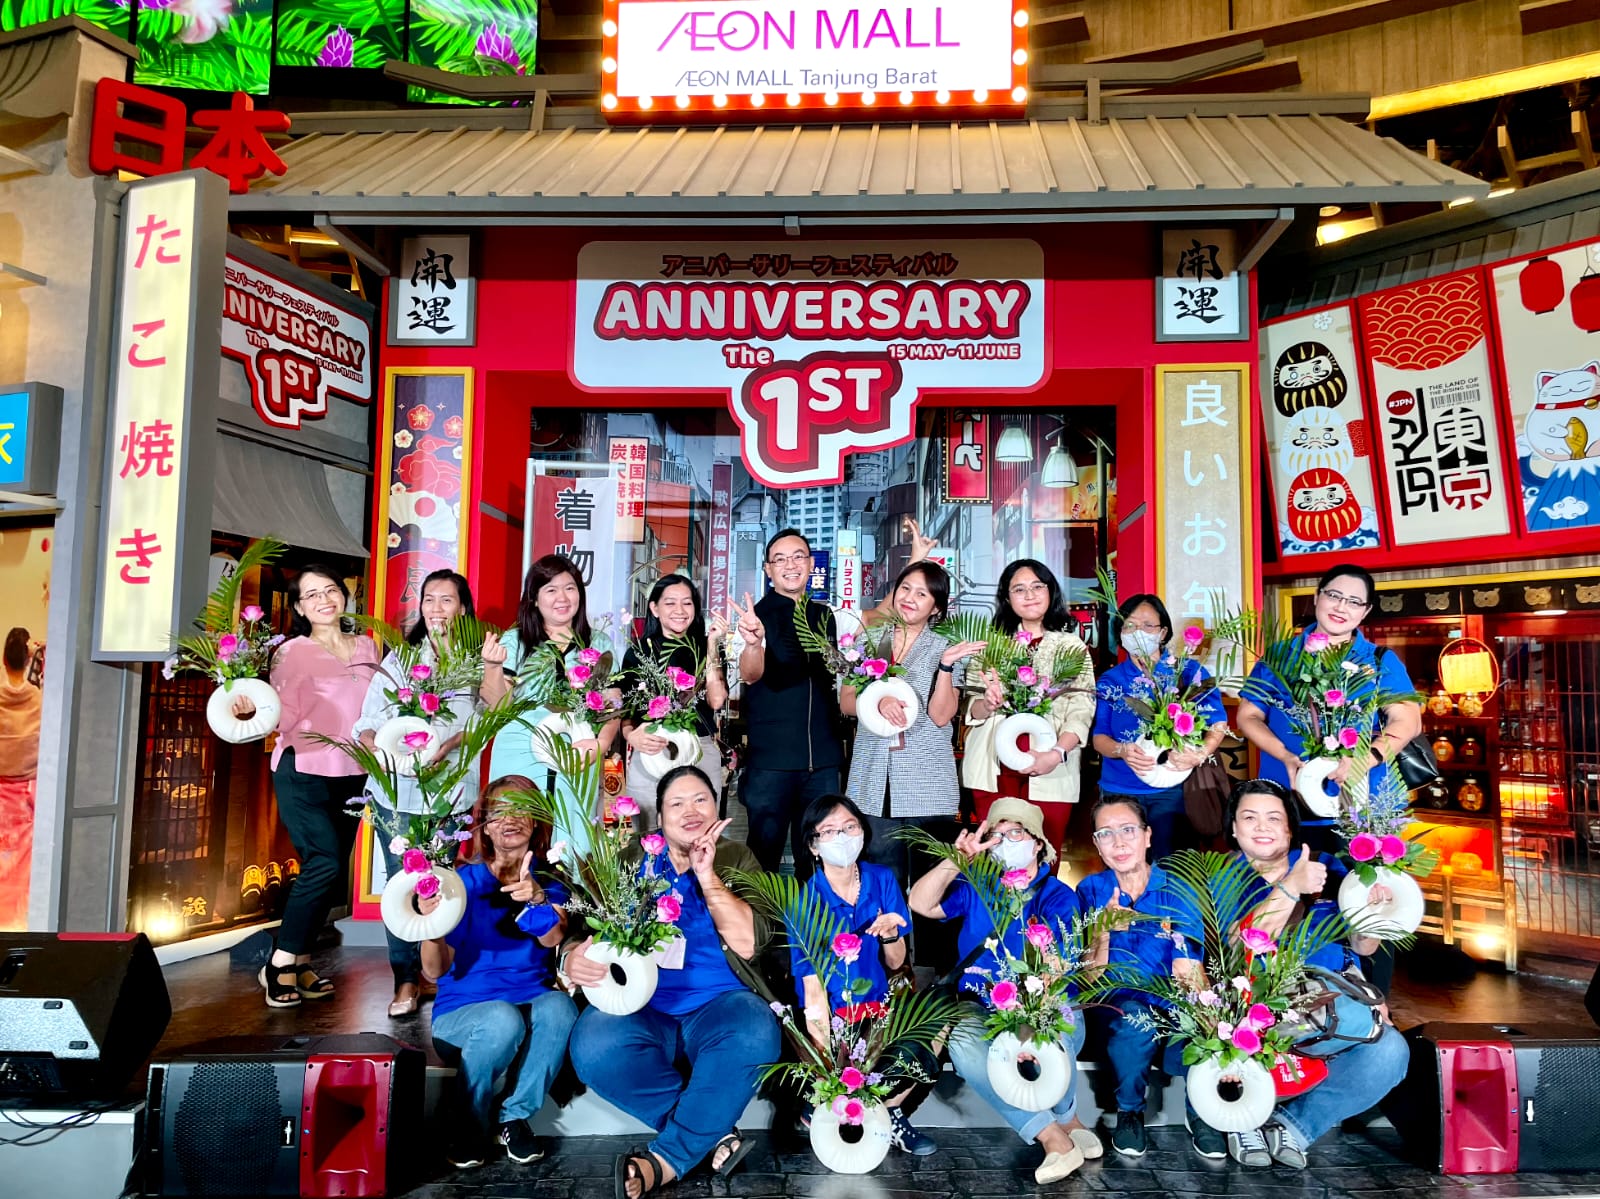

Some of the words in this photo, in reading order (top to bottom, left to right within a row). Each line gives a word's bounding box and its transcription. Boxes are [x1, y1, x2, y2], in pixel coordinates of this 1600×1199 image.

[816, 7, 960, 49] MALL
[736, 69, 794, 87] MALL
[799, 69, 878, 89] Tanjung
[885, 67, 938, 84] Barat
[89, 77, 291, 194] 日本
[223, 289, 363, 366] NIVERSARY
[600, 285, 1023, 334] ANNIVERSARY
[246, 330, 268, 348] The
[725, 345, 771, 366] The
[888, 344, 907, 360] 15
[909, 344, 946, 360] MAY
[958, 344, 974, 360] 11
[975, 344, 1020, 360] JUNE
[115, 214, 181, 585] たこ焼き
[263, 357, 314, 404] 1ST
[1388, 397, 1413, 409] #JPN
[1445, 379, 1466, 388] LAND
[759, 366, 882, 451] 1ST
[1434, 407, 1491, 511] 東京
[555, 489, 596, 587] 着物
